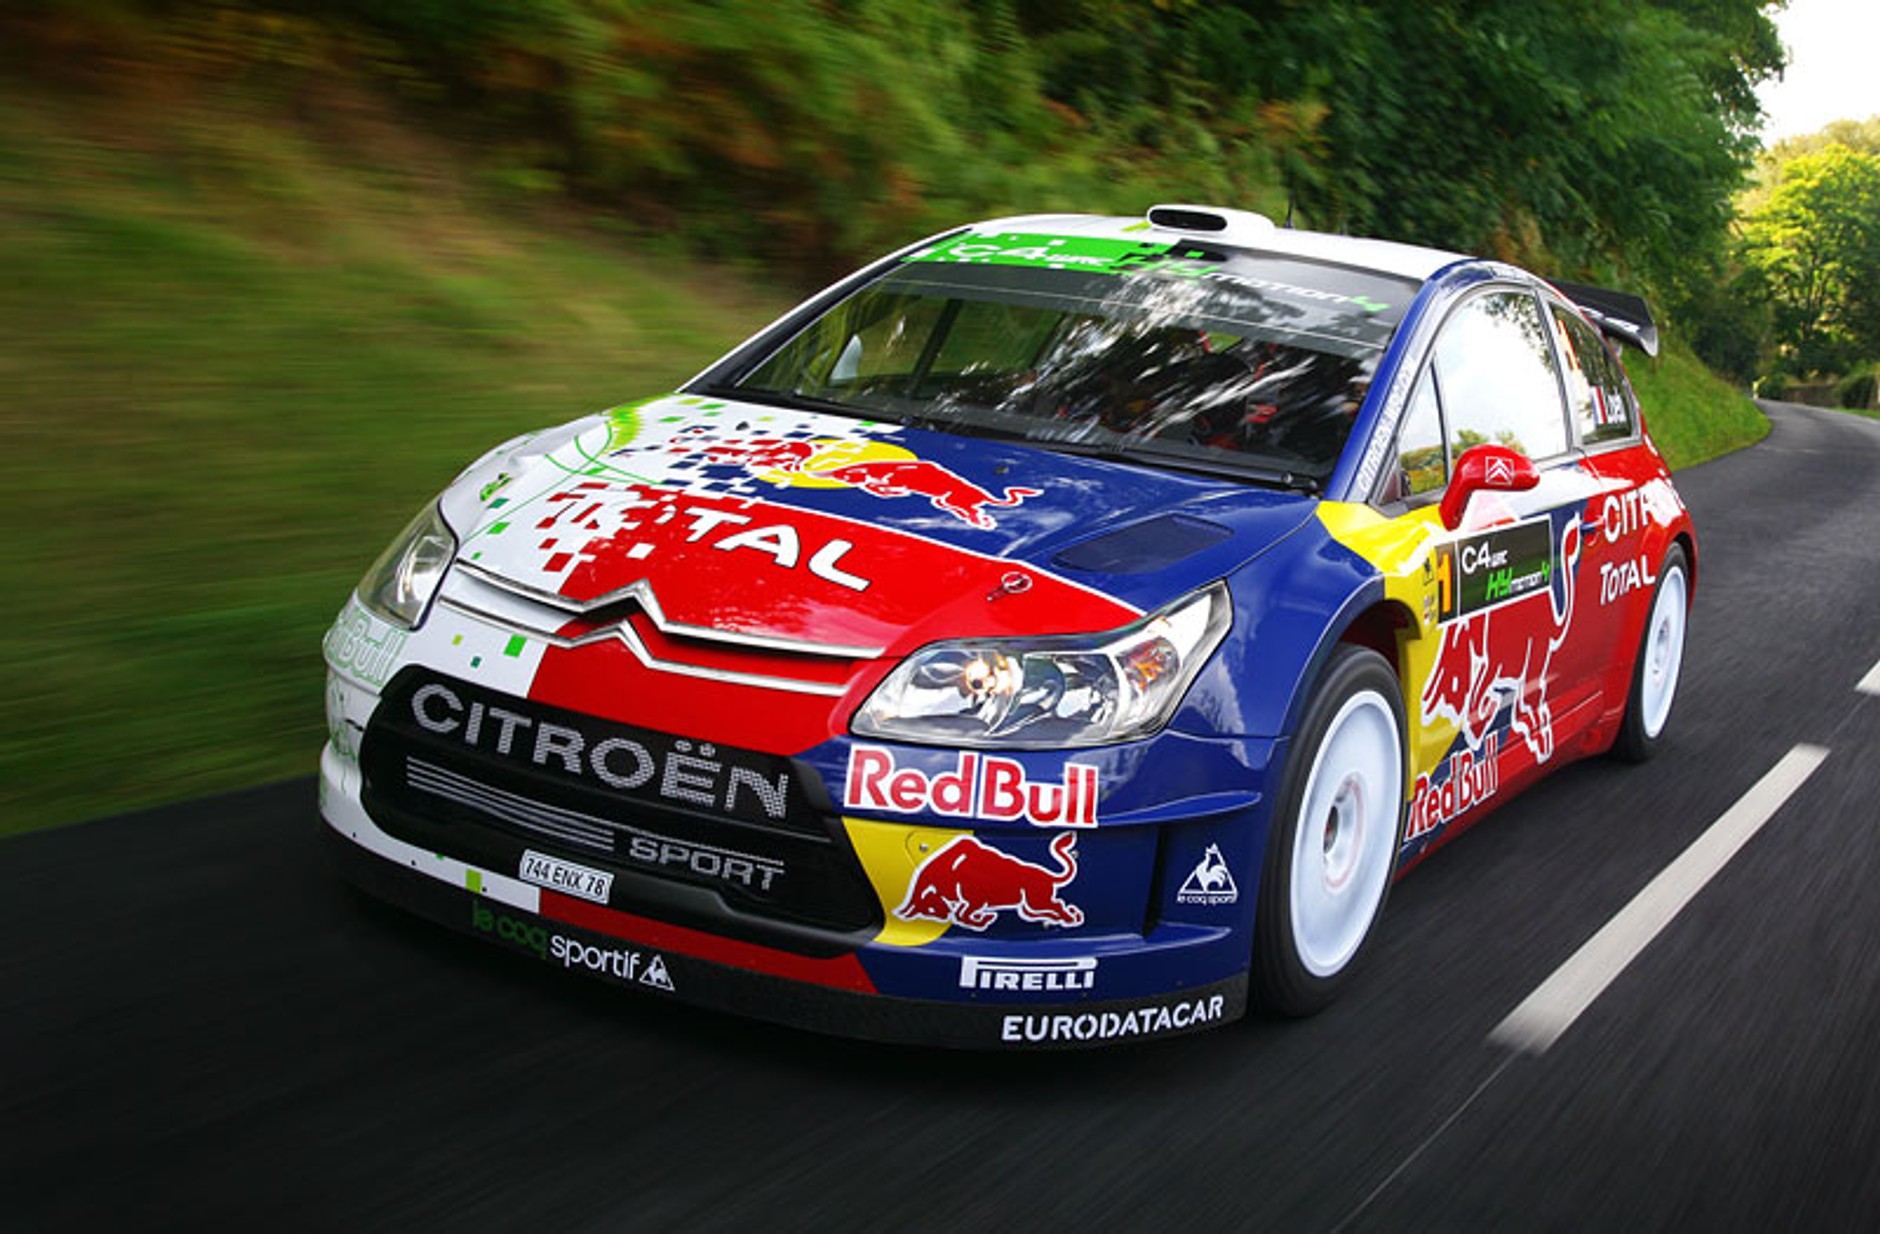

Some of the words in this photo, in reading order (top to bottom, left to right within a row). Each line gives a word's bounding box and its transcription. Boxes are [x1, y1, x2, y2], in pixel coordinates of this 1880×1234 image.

[1461, 541, 1490, 574] C4
[1600, 555, 1656, 605] TOTAL
[411, 683, 788, 820] CITROËN
[525, 858, 550, 878] 744
[552, 866, 584, 889] ENX
[587, 875, 606, 896] 78
[629, 834, 786, 890] SPORT
[472, 899, 494, 930] le
[497, 917, 548, 960] coq
[550, 934, 641, 980] sportif
[959, 955, 1098, 990] PIRELLI
[1001, 995, 1224, 1042] EURODATACAR
